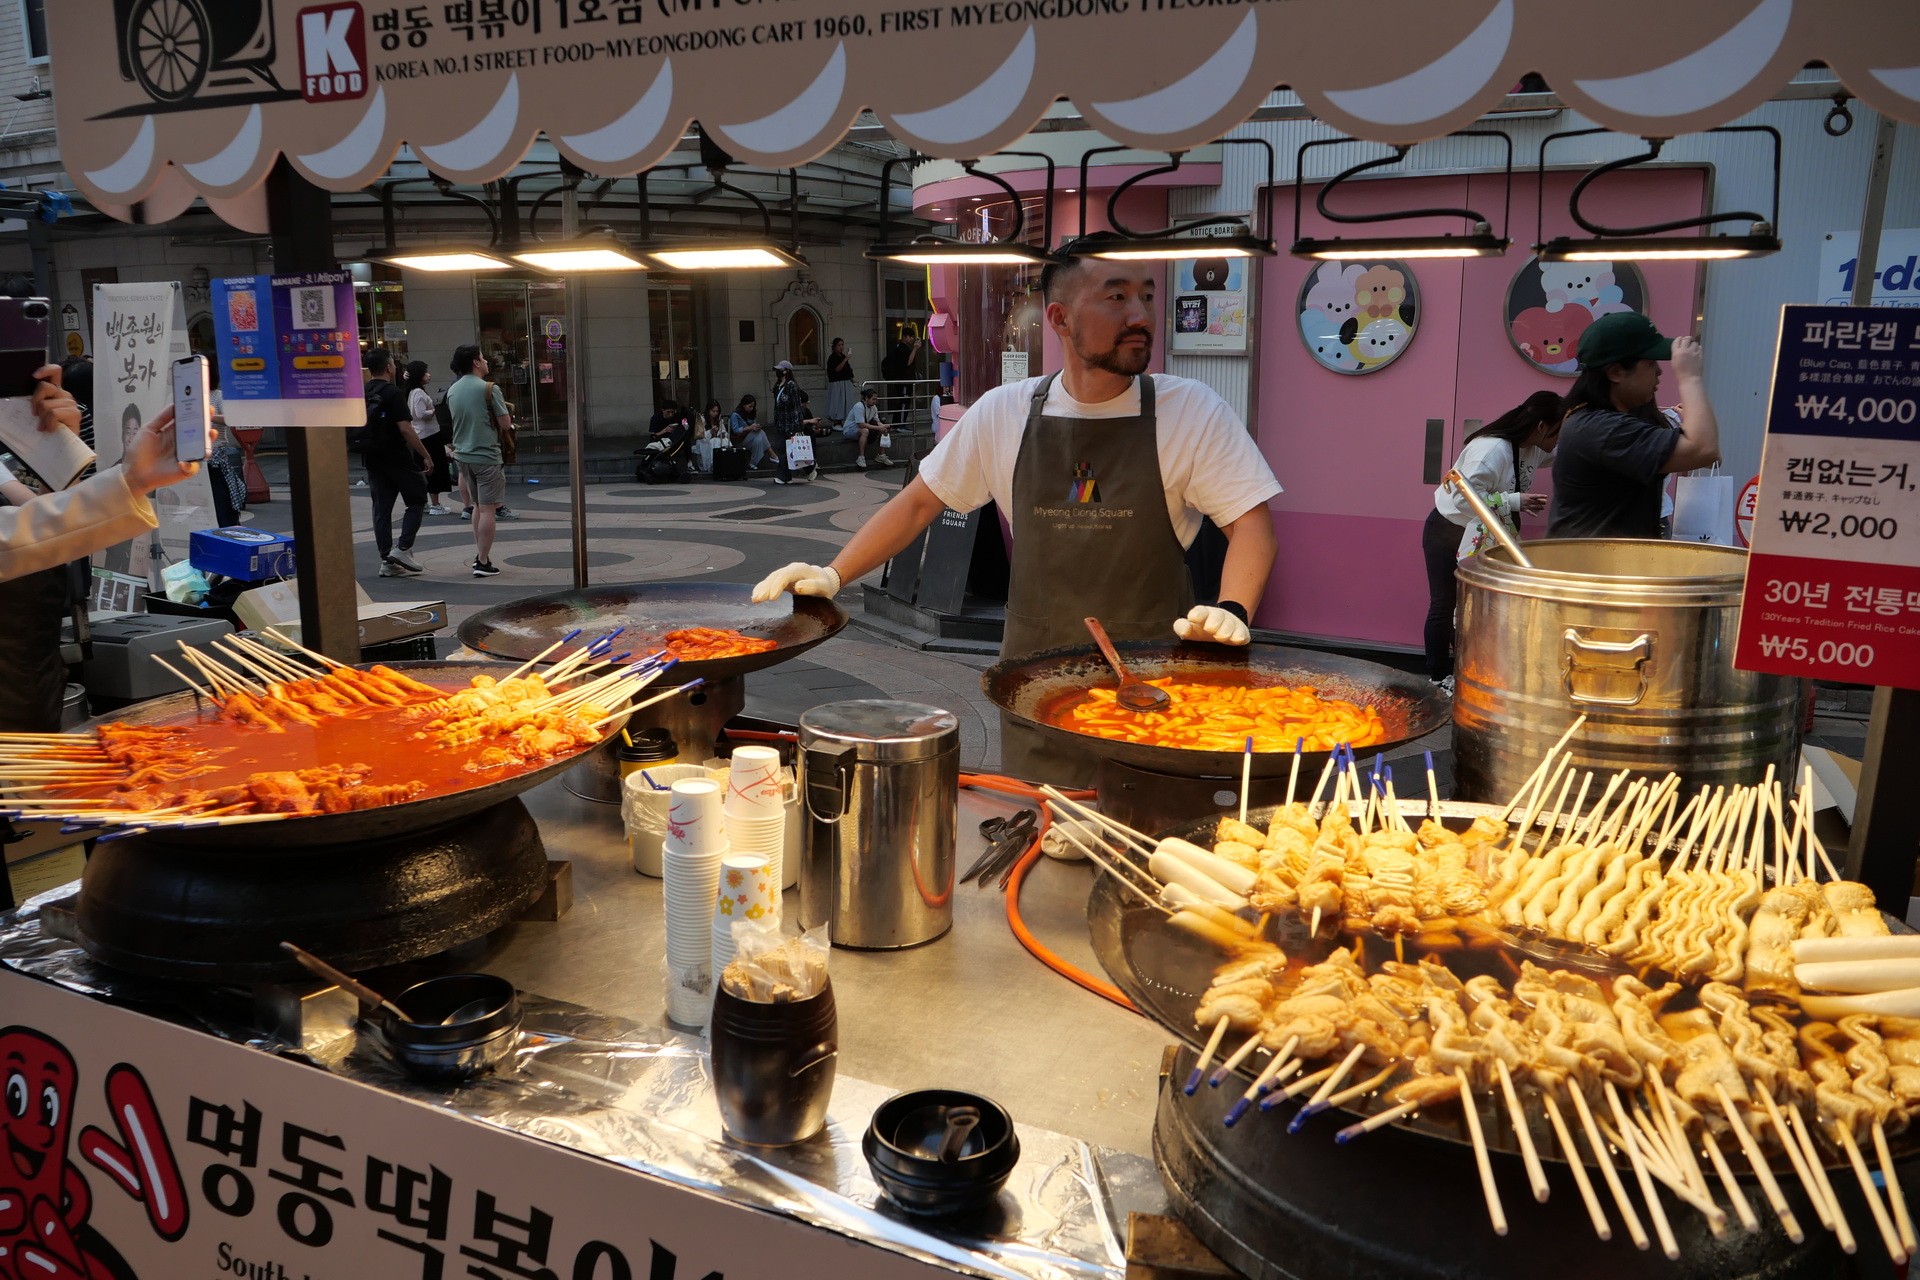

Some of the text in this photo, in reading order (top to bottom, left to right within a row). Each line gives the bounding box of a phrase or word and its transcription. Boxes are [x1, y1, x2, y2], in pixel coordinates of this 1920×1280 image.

[372, 5, 434, 51] 명동
[444, 0, 541, 42] 떡볶이
[301, 8, 361, 76] K
[374, 60, 430, 82] KOREA
[434, 54, 470, 76] NO.1
[474, 48, 538, 72] STREET
[751, 20, 807, 45] CART
[813, 14, 873, 40] 1960,
[880, 6, 943, 34] FIRST
[305, 72, 363, 97] FOOD
[105, 311, 165, 351] 백종원의
[1802, 320, 1899, 351] 파란캡
[118, 353, 157, 393] 본가
[1799, 358, 1826, 369] (Blue
[1795, 394, 1917, 425] ₩4,000
[1786, 457, 1916, 492] 캡없는거,
[941, 519, 967, 528] SQUARE
[943, 510, 969, 520] FRIENDS
[1033, 506, 1134, 519] Myeong Dong Square
[1779, 510, 1898, 540] ₩2,000
[1764, 579, 1831, 609] 30년
[1804, 616, 1845, 628] Tradition
[1847, 620, 1872, 631] Fried
[1874, 623, 1896, 634] Rice
[1758, 633, 1875, 668] ₩5,000
